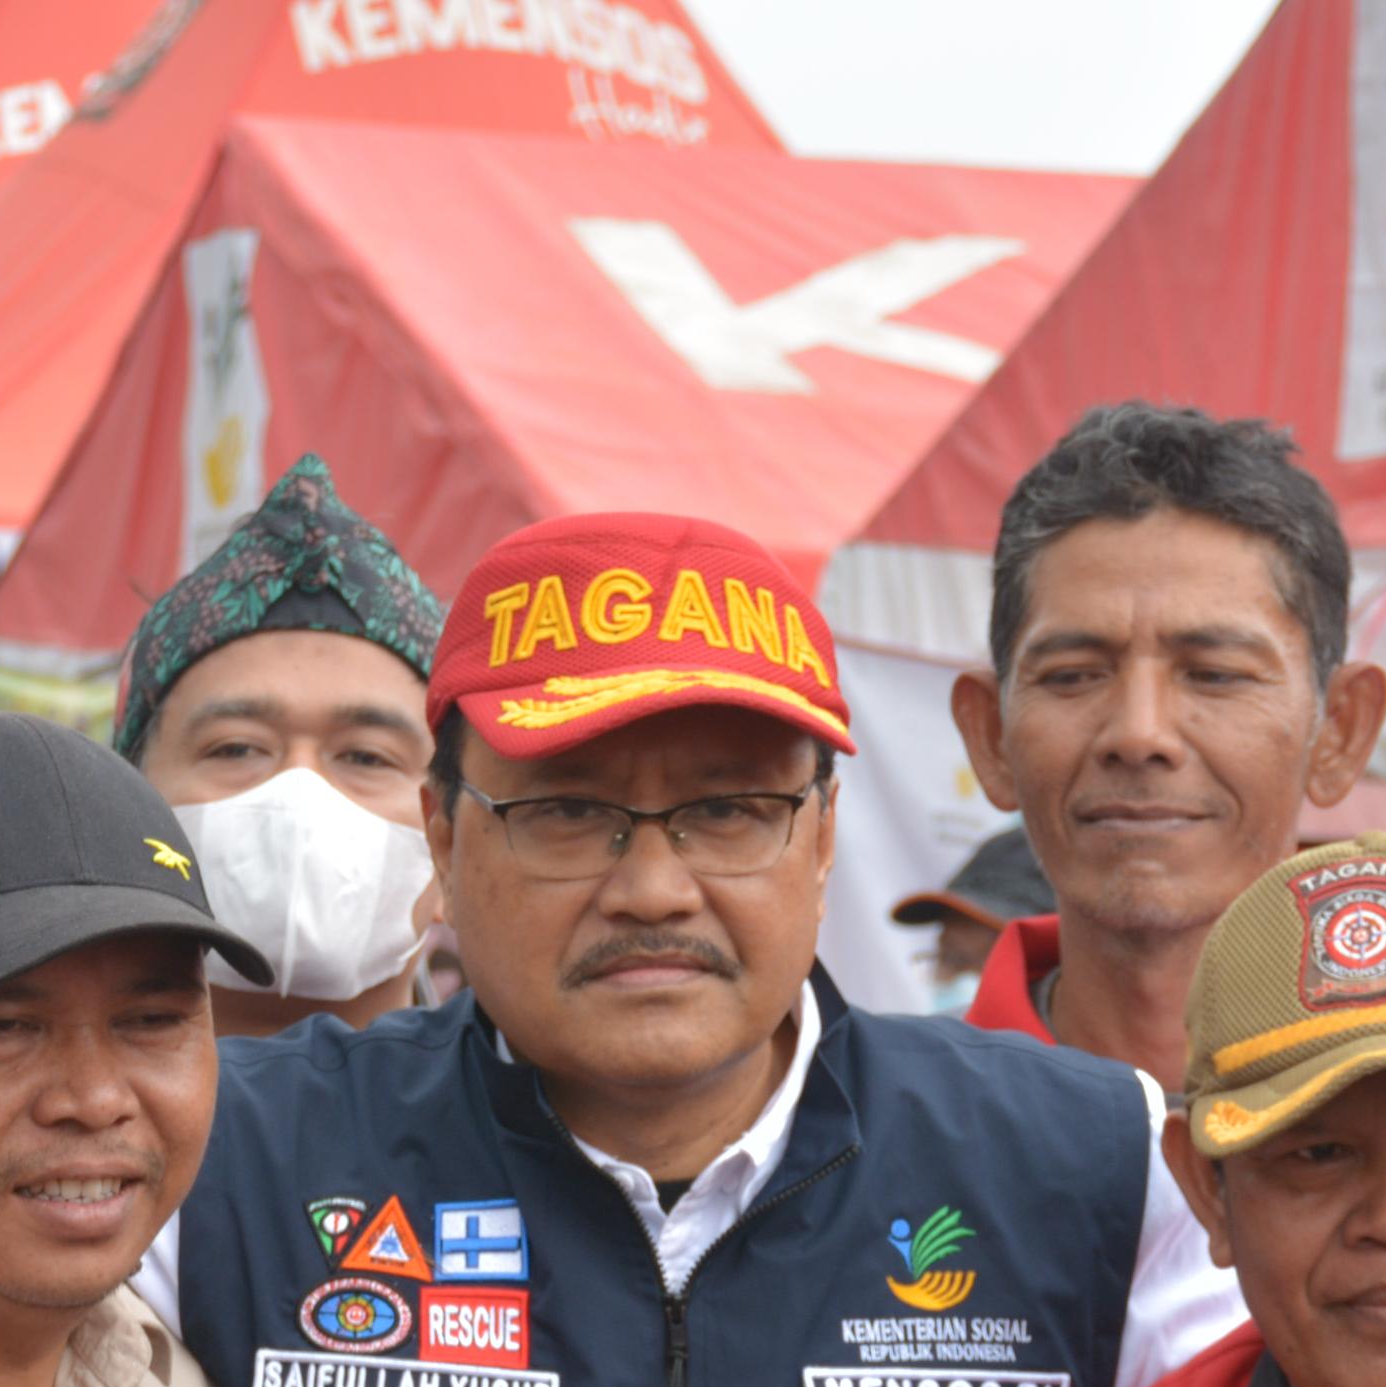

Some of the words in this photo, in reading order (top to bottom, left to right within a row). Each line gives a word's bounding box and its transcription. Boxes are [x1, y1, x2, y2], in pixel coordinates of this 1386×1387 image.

[289, 0, 708, 106] KEMENSOS
[484, 568, 831, 688] TAGANA
[428, 1304, 521, 1351] RESCUE
[841, 1318, 967, 1343] KEMENTERIAN
[971, 1318, 1031, 1343] SOSIAL
[859, 1344, 934, 1362] REPUBLIK
[936, 1343, 1016, 1362] INDONESIA
